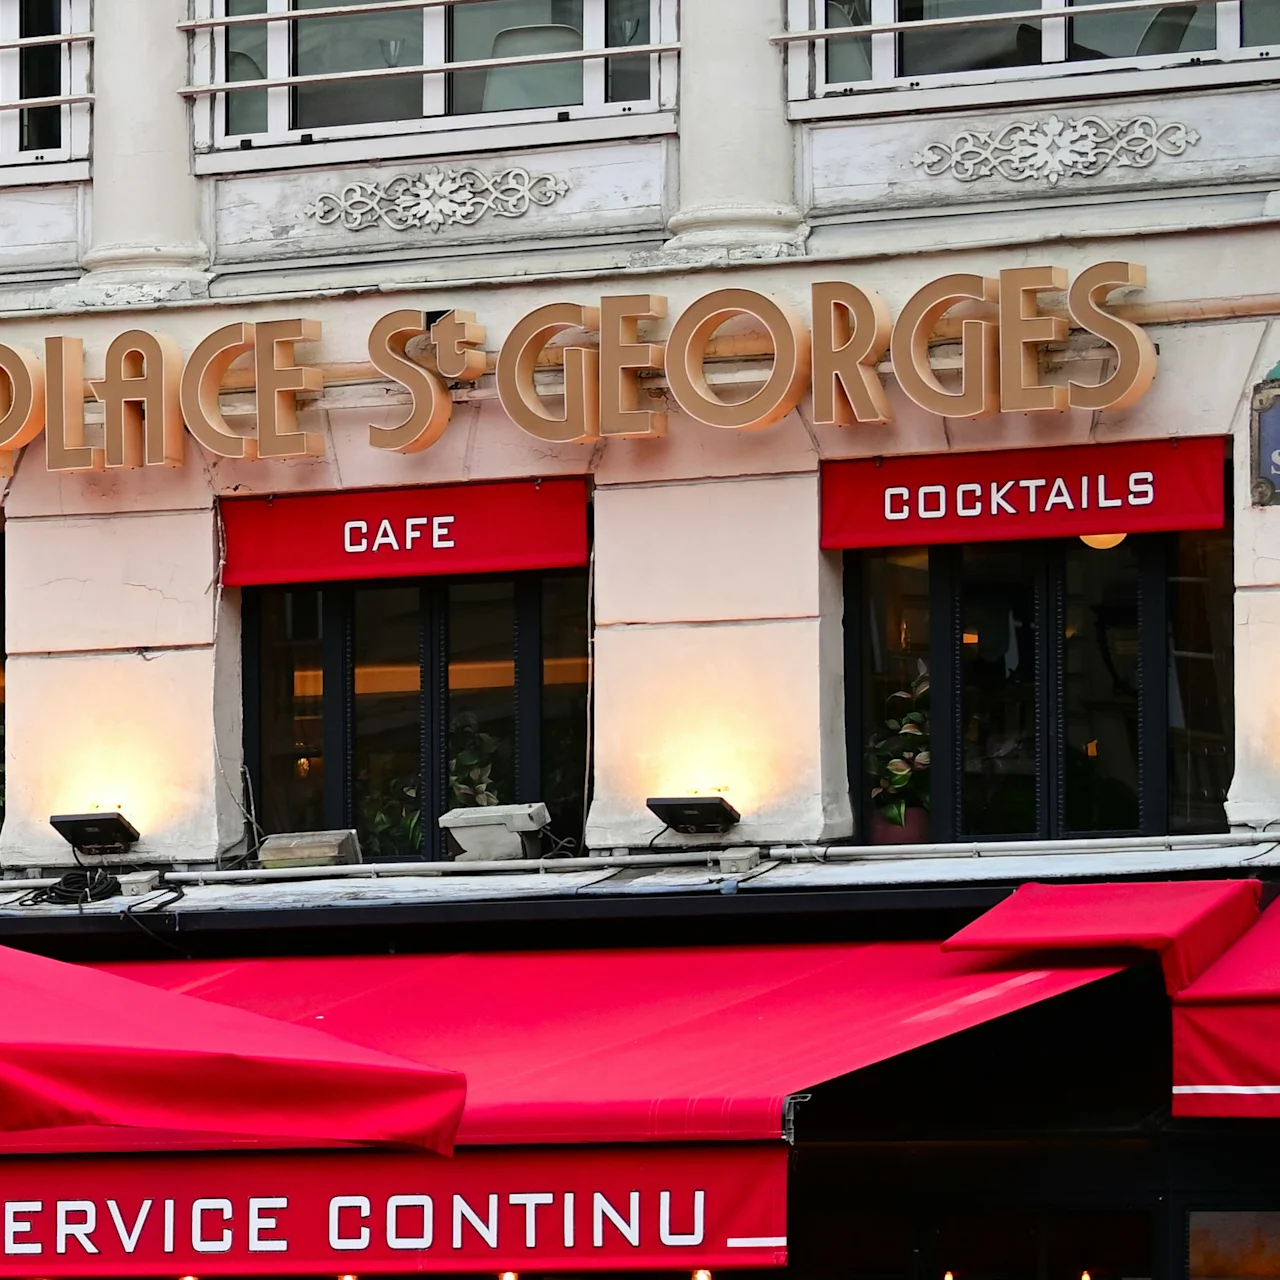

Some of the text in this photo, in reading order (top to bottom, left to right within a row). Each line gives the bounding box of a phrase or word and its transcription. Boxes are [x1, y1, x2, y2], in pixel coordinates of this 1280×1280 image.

[496, 261, 1157, 443] GEORGES
[884, 472, 1155, 521] COCKTAILS
[344, 516, 455, 553] CAFE
[327, 1189, 707, 1252] CONTINU
